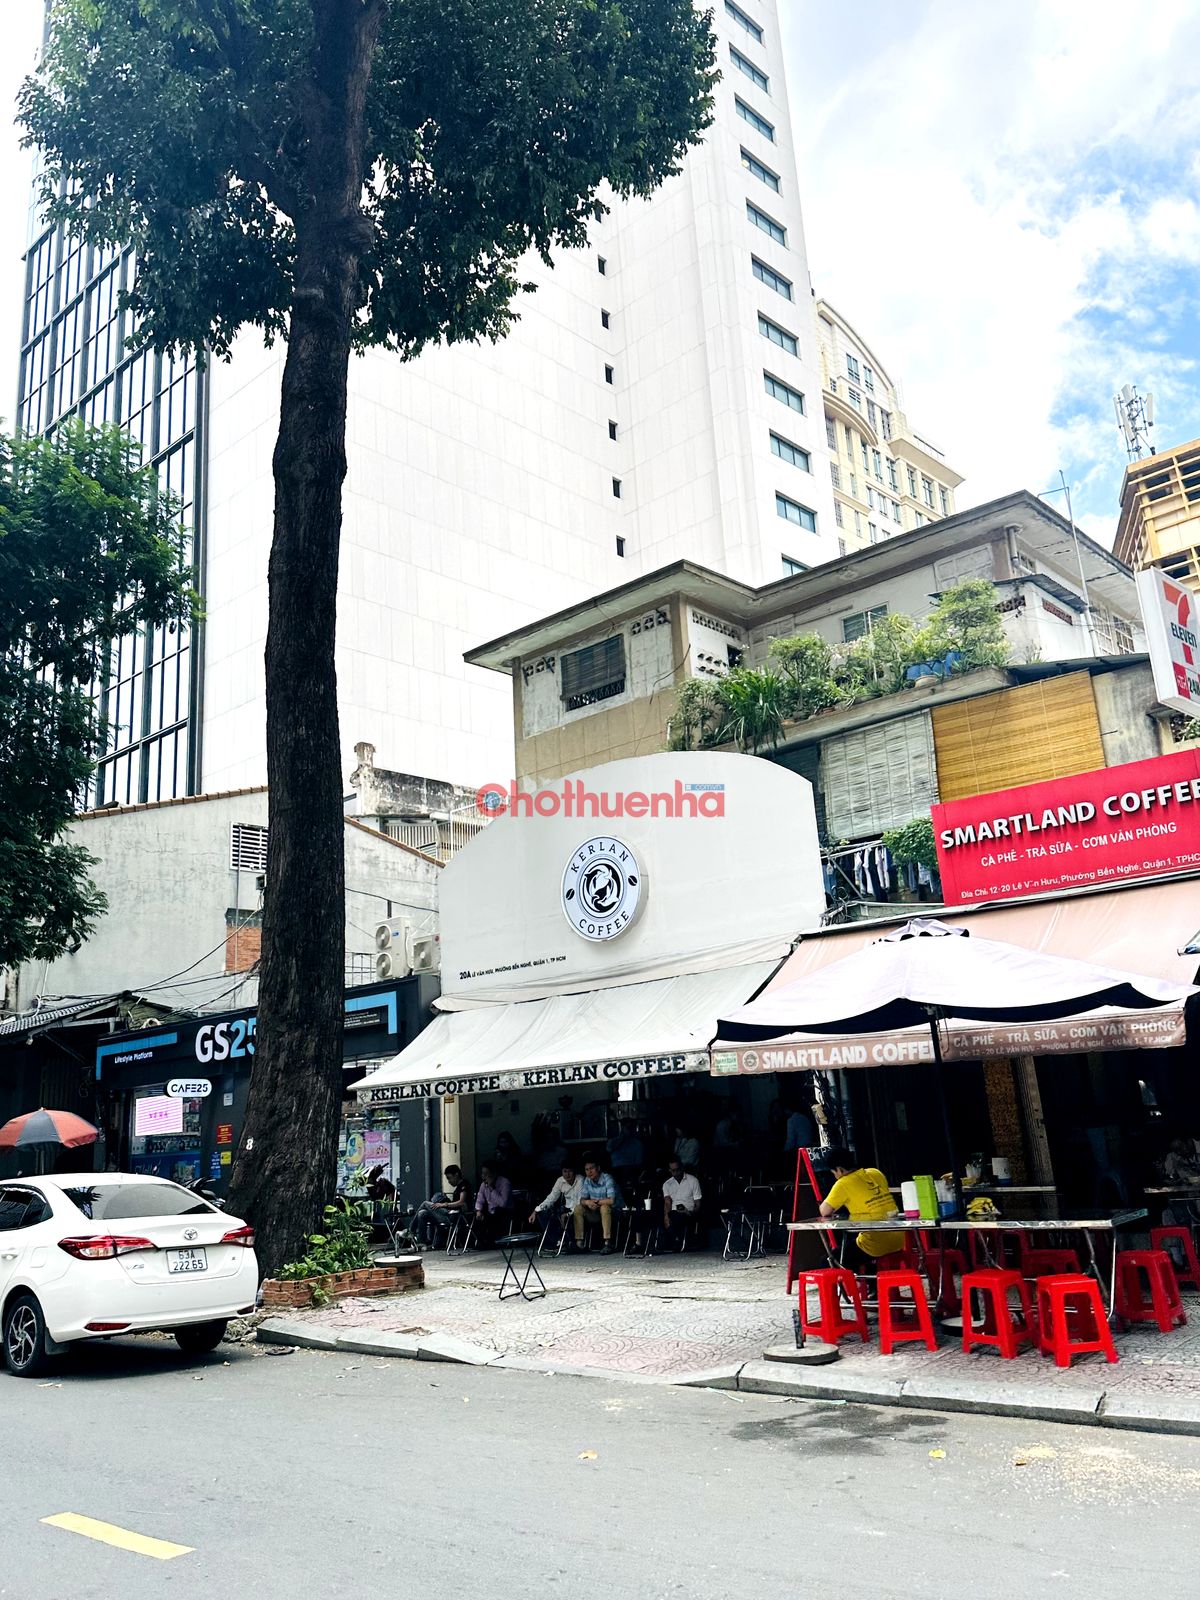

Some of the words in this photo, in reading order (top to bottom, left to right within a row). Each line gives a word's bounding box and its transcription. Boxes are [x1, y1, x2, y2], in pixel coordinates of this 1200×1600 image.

[940, 801, 1096, 849] SMARTLAND
[570, 841, 629, 873] KERLAN
[981, 853, 996, 867] CÀ
[1026, 845, 1047, 859] TRÀ
[1049, 841, 1073, 854] SỮA
[1082, 835, 1108, 849] CƠM
[1110, 829, 1134, 844] VĂN
[1136, 822, 1177, 840] PHÒNG
[1012, 882, 1023, 891] Lê
[578, 910, 629, 936] COFFEE
[459, 970, 472, 980] 20A
[114, 1054, 133, 1064] Lifestyle
[133, 1051, 153, 1061] Platform
[762, 1045, 869, 1069] SMARTLAND
[522, 1064, 598, 1087] KERLAN
[602, 1055, 686, 1078] COFFEE
[170, 1083, 209, 1093] CAFE25
[370, 1083, 431, 1102] KERLAN
[434, 1075, 501, 1096] COFFEE
[245, 1137, 254, 1150] 8
